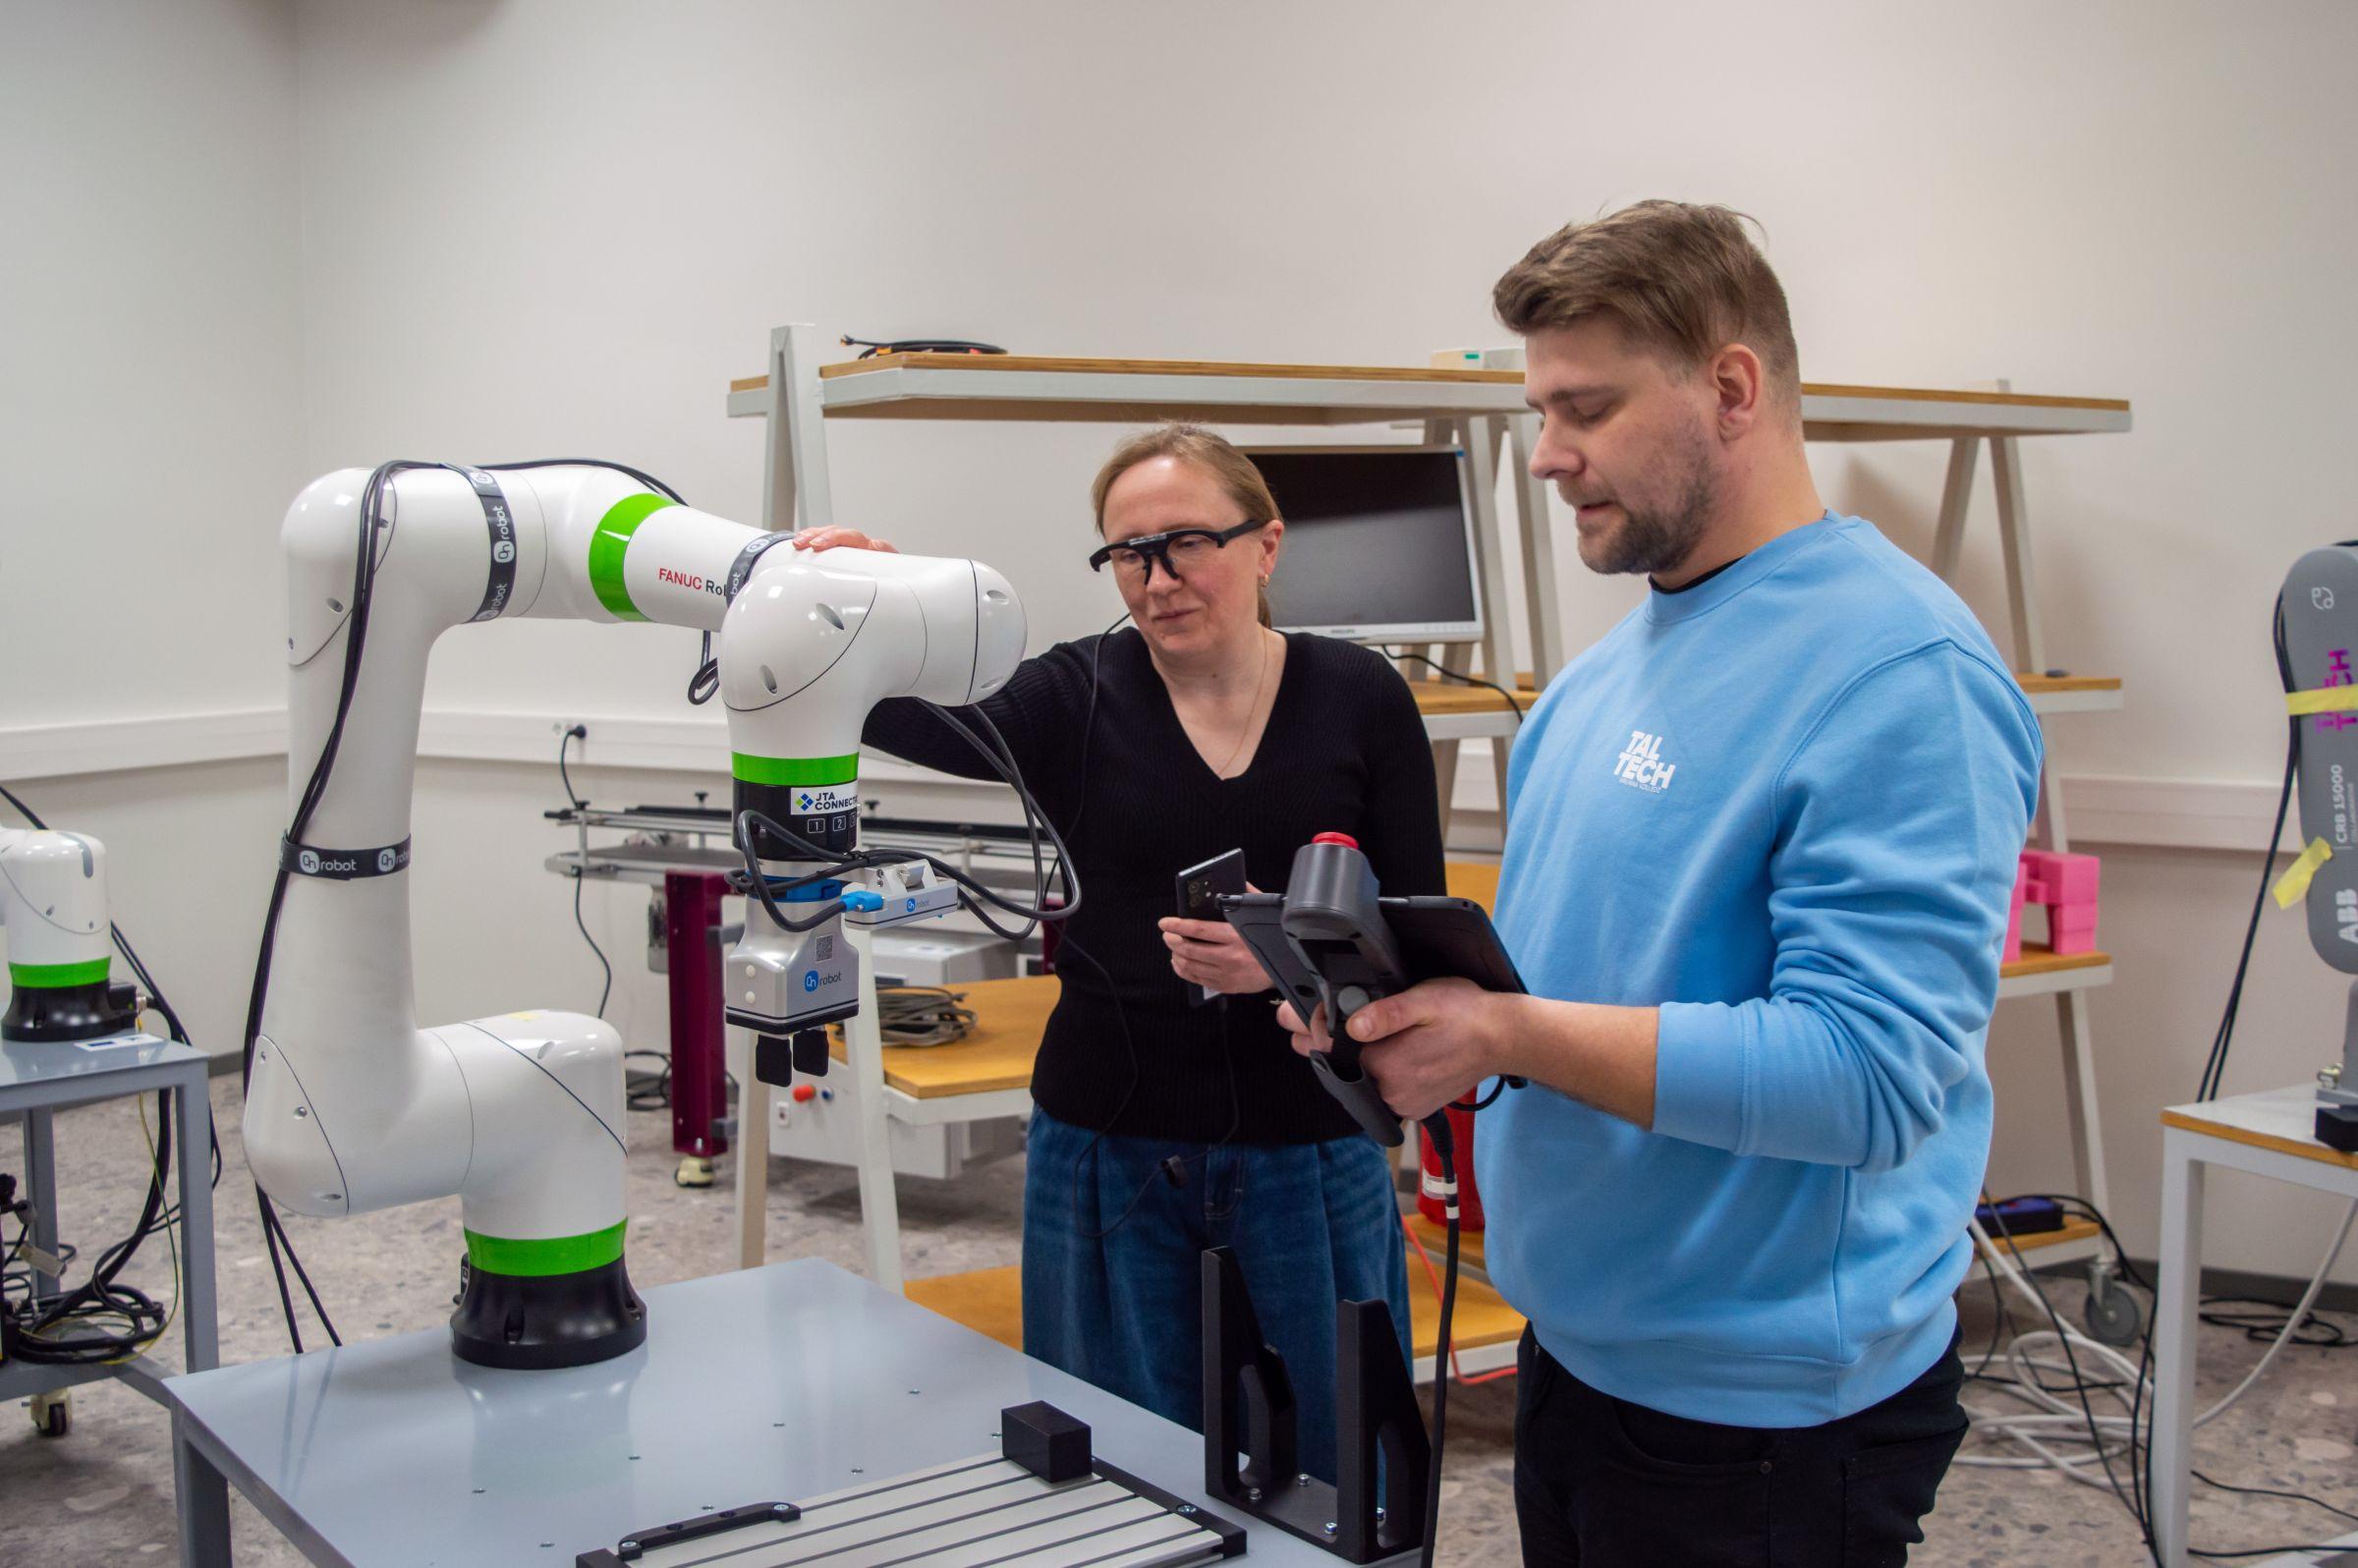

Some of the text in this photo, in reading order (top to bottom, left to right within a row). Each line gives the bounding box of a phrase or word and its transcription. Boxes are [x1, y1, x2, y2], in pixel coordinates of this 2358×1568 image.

[659, 568, 702, 590] FANUC
[730, 572, 742, 595] bot
[1626, 731, 1663, 760] TAL
[1613, 752, 1676, 790] TECH
[816, 792, 835, 802] JTA
[2330, 764, 2347, 843] CRB 15000
[320, 859, 358, 871] robot
[2335, 889, 2358, 944] ABB
[819, 971, 842, 985] robot
